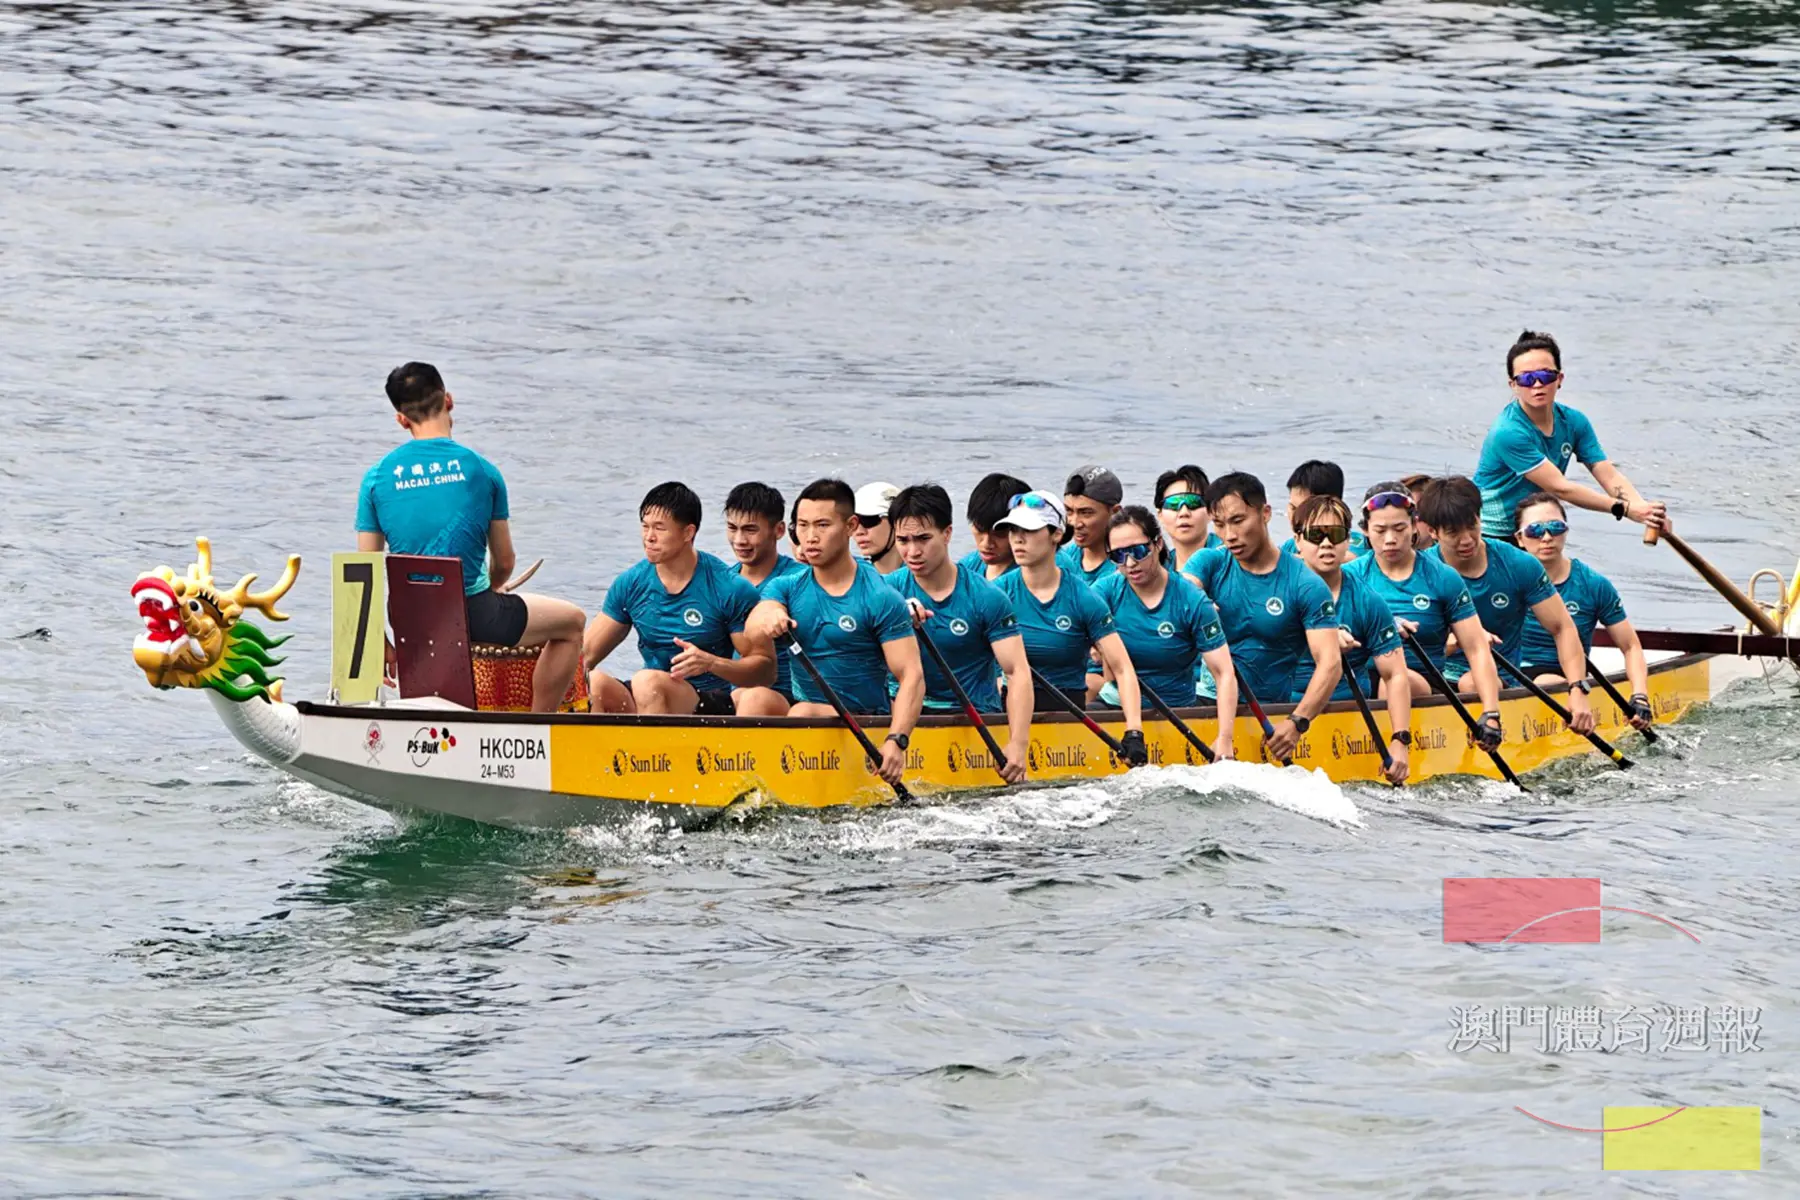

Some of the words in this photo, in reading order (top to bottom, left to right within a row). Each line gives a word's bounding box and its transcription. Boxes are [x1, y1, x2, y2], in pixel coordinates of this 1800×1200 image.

[343, 563, 373, 679] 7
[480, 738, 546, 759] HKCDBA
[1346, 735, 1362, 755] Sun
[1414, 730, 1430, 750] Sun
[1431, 727, 1446, 749] Life
[630, 755, 650, 773] Sun
[652, 753, 671, 772] Life
[714, 753, 735, 772] Sun
[737, 750, 756, 771] Life
[799, 752, 819, 770] Sun
[821, 749, 840, 770] Life
[905, 748, 924, 769] Life
[965, 748, 984, 769] Sun
[1046, 746, 1065, 767] Sun
[1068, 744, 1086, 766] Life
[481, 764, 515, 779] 24-M53
